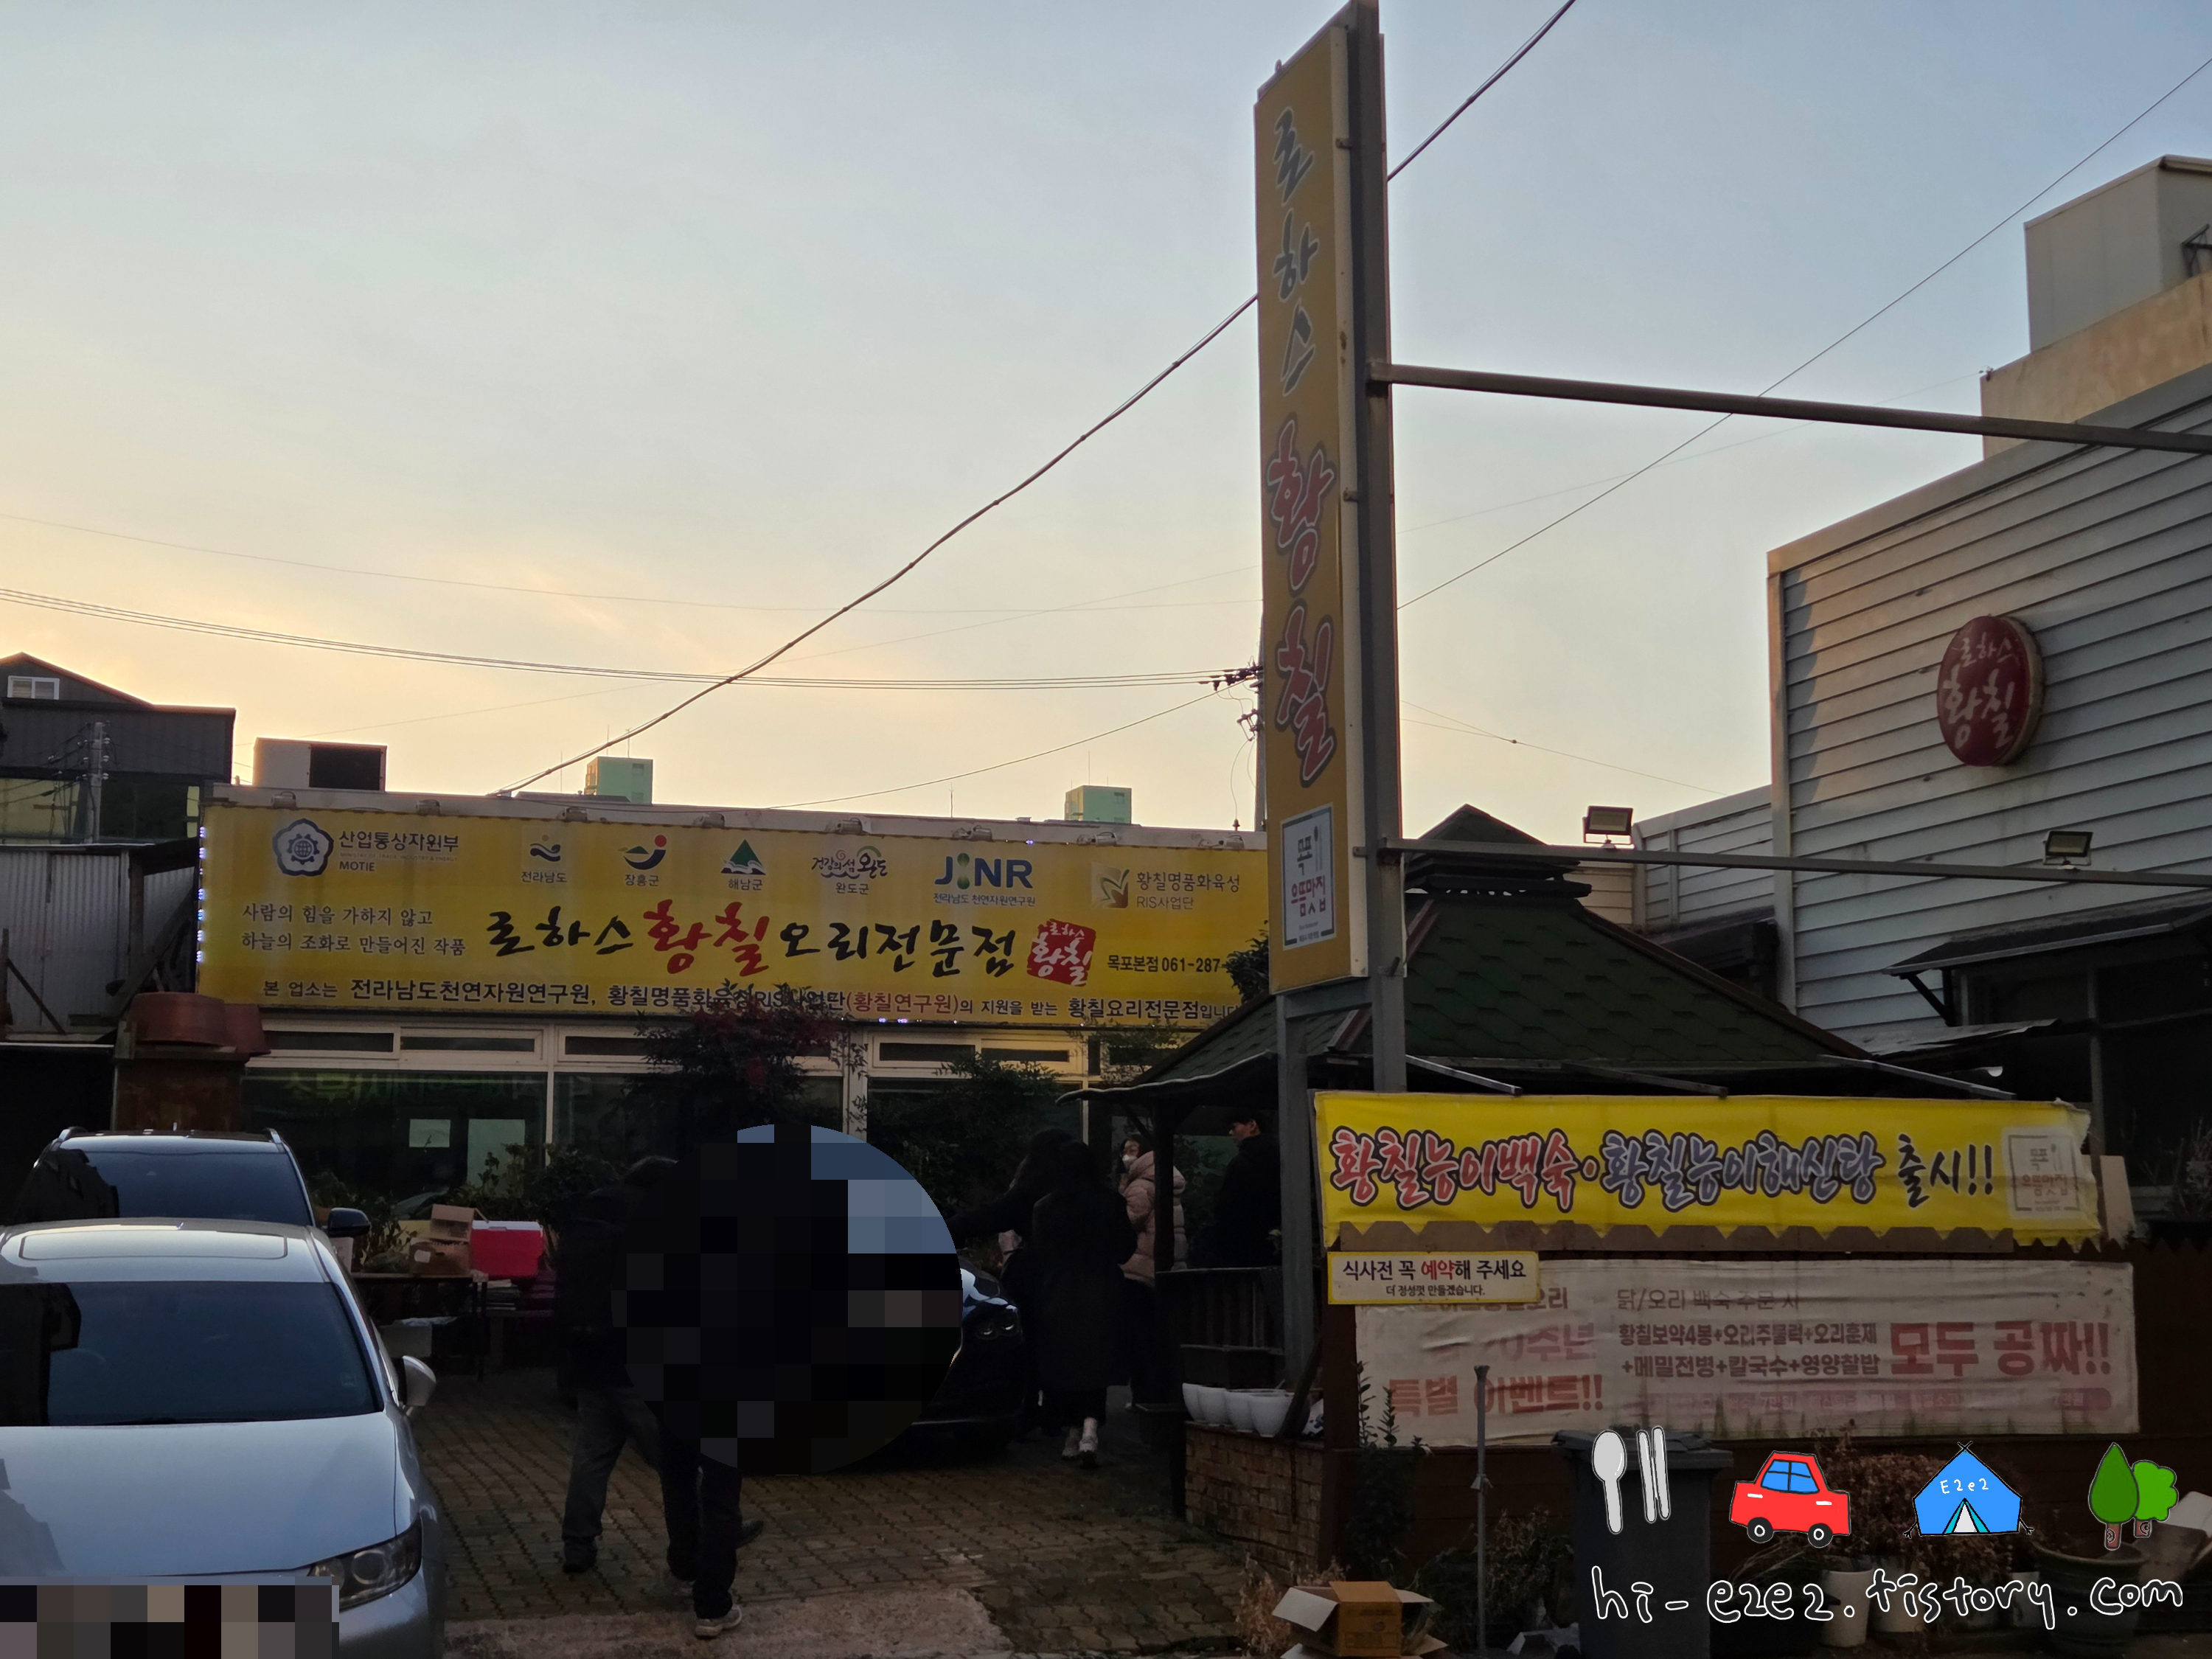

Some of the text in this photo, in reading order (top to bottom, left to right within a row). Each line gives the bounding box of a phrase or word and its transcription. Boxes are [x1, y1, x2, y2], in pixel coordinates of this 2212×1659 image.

[1266, 106, 1335, 785] 로하스 황칠
[1960, 632, 2020, 667] 로하스
[1943, 664, 2015, 750] 황칠
[338, 830, 459, 852] 산업통상자원부
[338, 861, 375, 872] MOTIE
[521, 871, 568, 884] 전라남도
[624, 874, 660, 887] 장흥군
[727, 878, 764, 891] 해남군
[835, 882, 870, 895] 완도군
[1136, 871, 1241, 893] 황칠명품화육성
[933, 892, 1036, 908] 전라남도 천연자원연구원
[1136, 896, 1194, 910] RIS사업단
[242, 902, 434, 928] 사람의 힘을 가하지 않고
[486, 898, 1017, 978] 로하스 황칠 오리전문점
[1049, 922, 1085, 940] 로하스
[241, 931, 467, 956] 하늘의 조화로 만들어진 작품
[1032, 932, 1093, 987] 황칠
[1107, 955, 1159, 972] 목포본점
[263, 980, 280, 996] 본
[288, 981, 338, 998] 업소는
[350, 978, 596, 1006] 전라남도천연자원연구원,
[981, 998, 1023, 1015] 지원을
[1031, 1001, 1058, 1016] 받는
[1898, 1133, 1994, 1208] 출시!!
[1343, 1259, 1527, 1281] 식사전 꼭 예약해 주세요
[1385, 1284, 1486, 1297] 더 정성껏 만들겠습니다.
[1617, 1288, 1686, 1312] 닭/오리
[1890, 1321, 2111, 1377] 모두 공짜!!
[1389, 1374, 1604, 1417] 특별 이벤트!!
